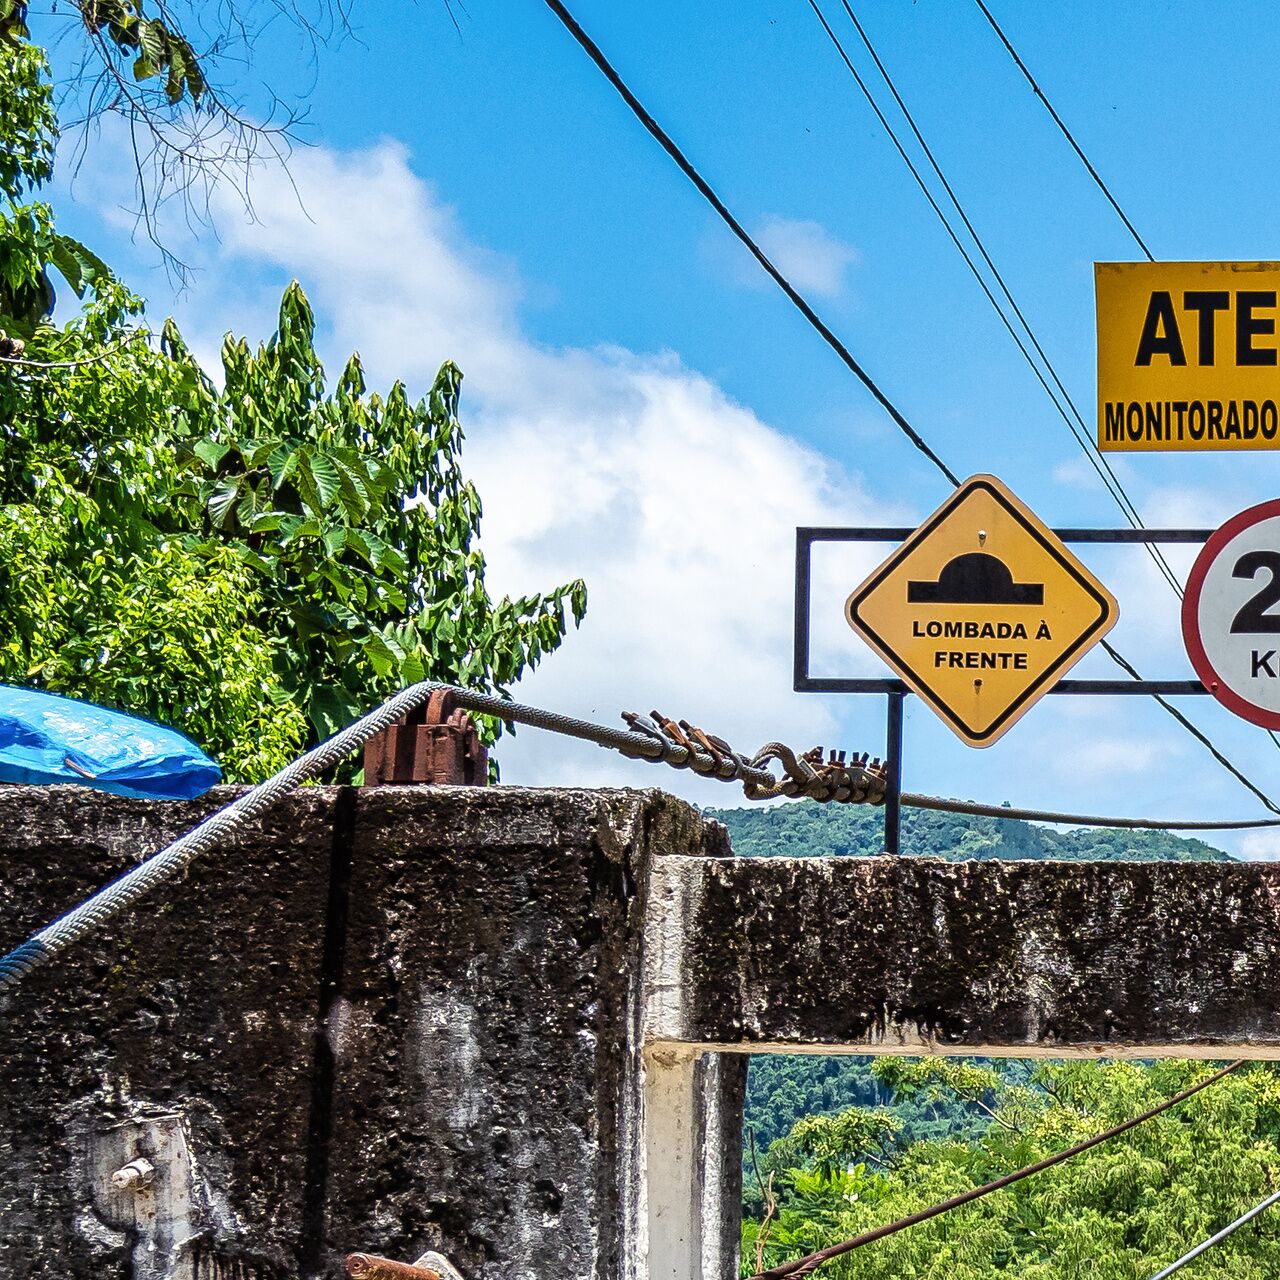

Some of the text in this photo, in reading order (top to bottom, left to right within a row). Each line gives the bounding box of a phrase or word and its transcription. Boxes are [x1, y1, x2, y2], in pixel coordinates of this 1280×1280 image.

[1104, 399, 1278, 442] MONITORADO
[912, 619, 1052, 641] LOMBADA À
[934, 651, 1028, 670] FRENTE
